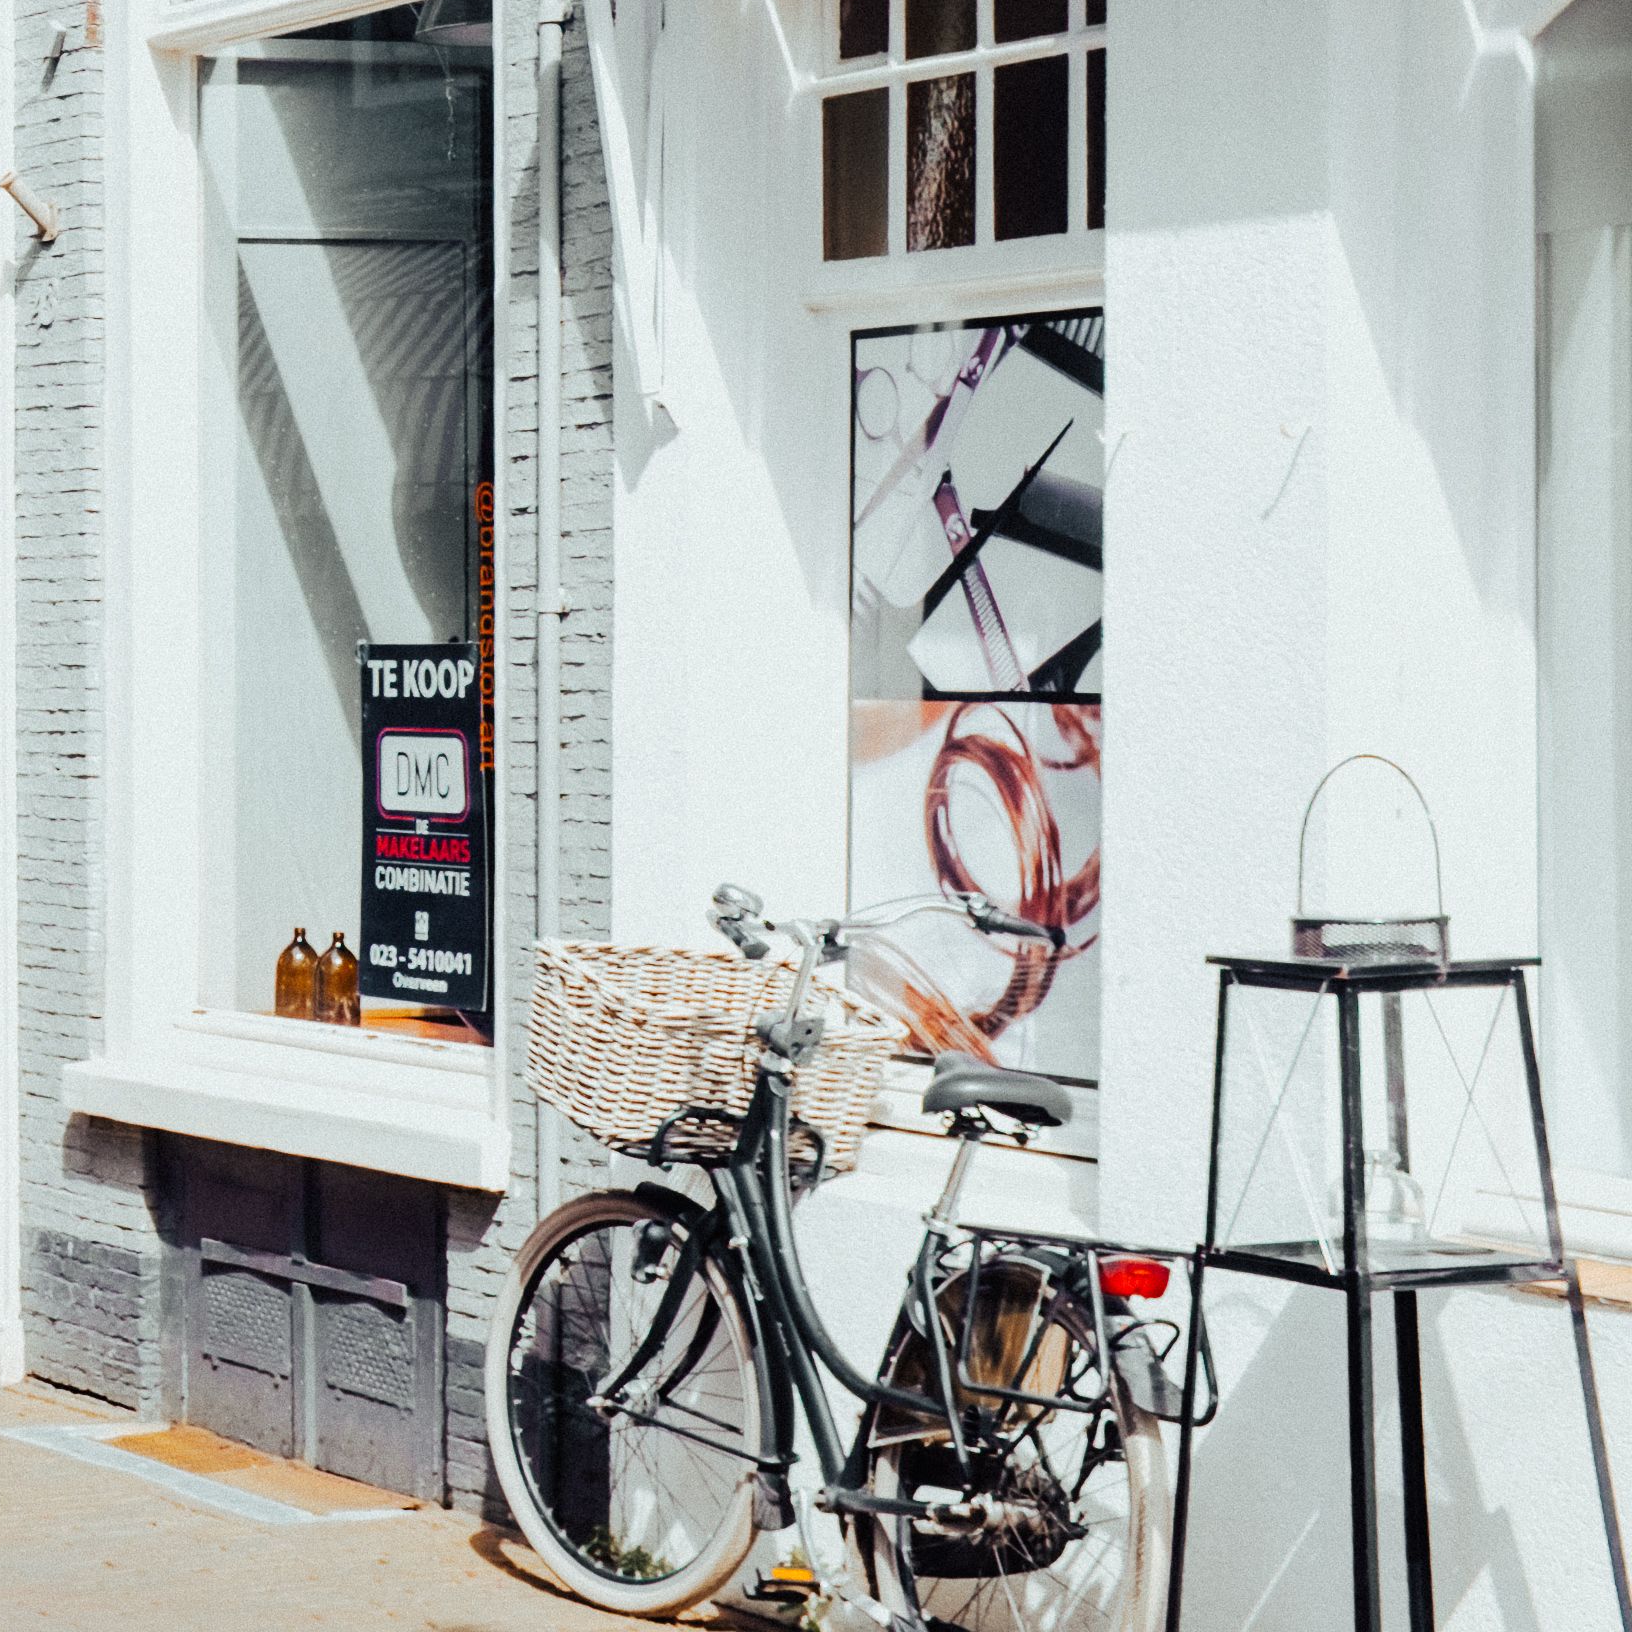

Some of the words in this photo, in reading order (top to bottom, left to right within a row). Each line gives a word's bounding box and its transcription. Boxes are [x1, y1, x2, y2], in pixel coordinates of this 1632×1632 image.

[367, 659, 398, 698] TE
[403, 658, 475, 699] KOOP
[396, 751, 450, 799] DMC
[375, 835, 472, 863] MAKELAARS
[375, 865, 471, 897] COMBINATIE
[370, 943, 398, 968] 023
[407, 946, 473, 976] 5410041
